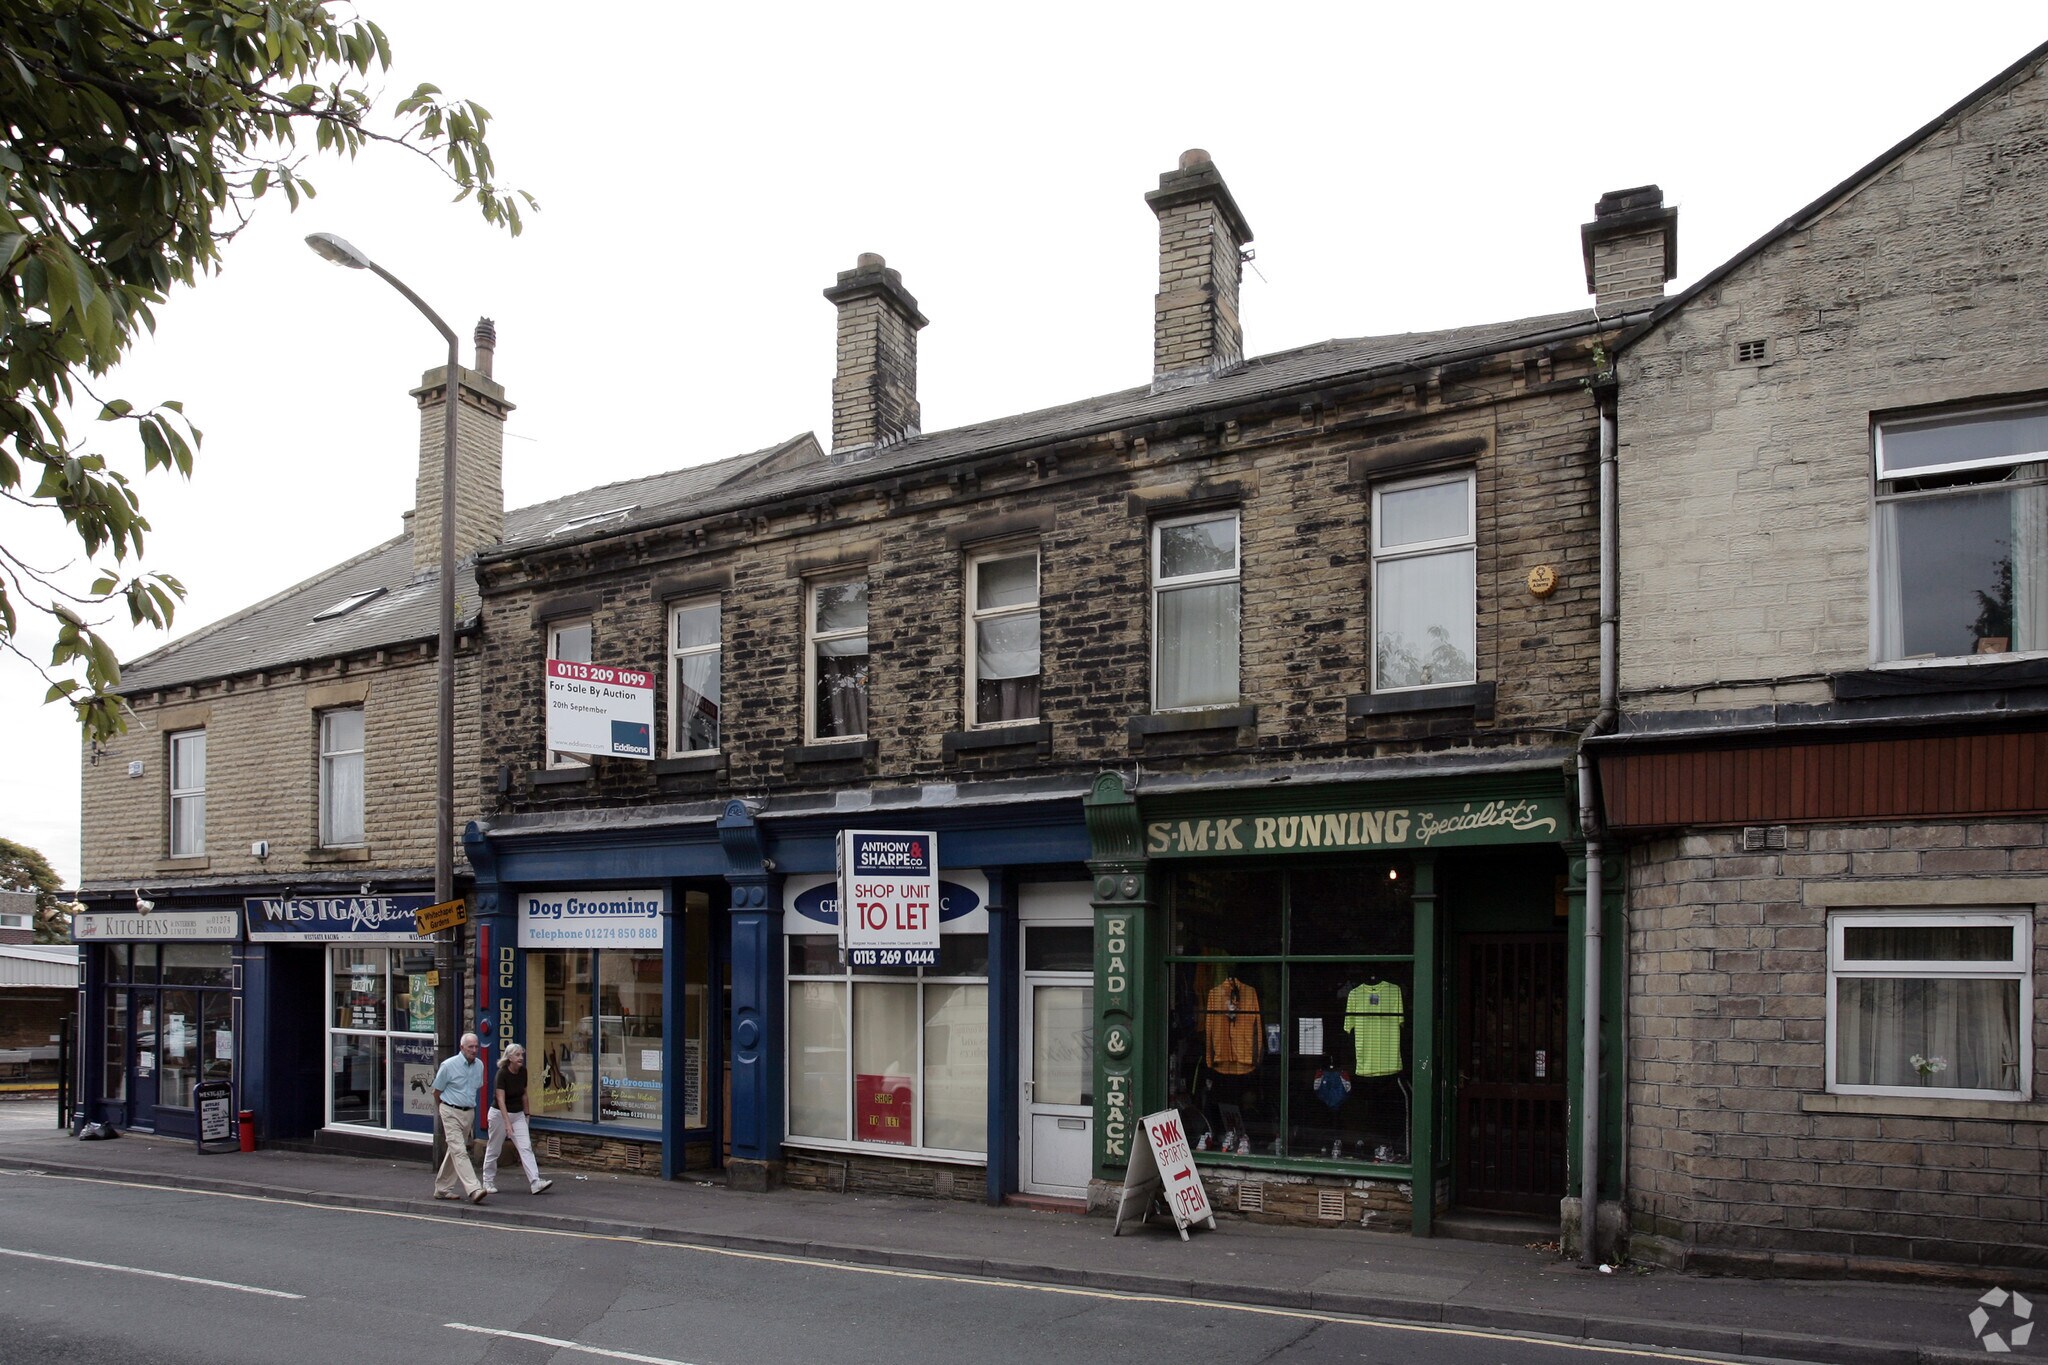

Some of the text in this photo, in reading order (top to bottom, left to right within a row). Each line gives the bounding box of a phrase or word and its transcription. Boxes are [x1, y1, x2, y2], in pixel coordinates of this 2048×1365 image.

[557, 663, 646, 687] 0113 209 1099
[549, 681, 636, 700] For Sale By Auction
[552, 700, 608, 715] 20th September
[613, 742, 649, 755] Eddisons
[1253, 809, 1412, 849] RUNNING
[1415, 799, 1557, 846] Specialists
[861, 841, 922, 858] ANTHONY &
[855, 884, 931, 899] SHOP UNIT
[262, 898, 393, 921] WESTGATE
[424, 906, 454, 920] Whitechapel
[529, 896, 658, 920] Dog Grooming
[857, 902, 930, 931] TO LET
[105, 916, 168, 935] KITCHENS
[211, 915, 231, 924] 01274
[430, 918, 450, 929] Gardens
[205, 926, 231, 934] 870003
[530, 928, 658, 941] Telephone 01274 850 888
[853, 950, 935, 965] 0113 269 0444
[1107, 919, 1126, 993] ROAD
[500, 947, 515, 988] DOG
[1107, 1030, 1125, 1052] &
[602, 1075, 662, 1090] Dog Groomin
[874, 1093, 893, 1104] SHOP
[602, 1108, 630, 1117] Telephone
[870, 1114, 899, 1127] TO LET
[1106, 1076, 1125, 1156] TRACK
[1151, 1119, 1183, 1148] SMK
[1158, 1143, 1189, 1167] SPORTS
[1175, 1184, 1206, 1217] OPEN
